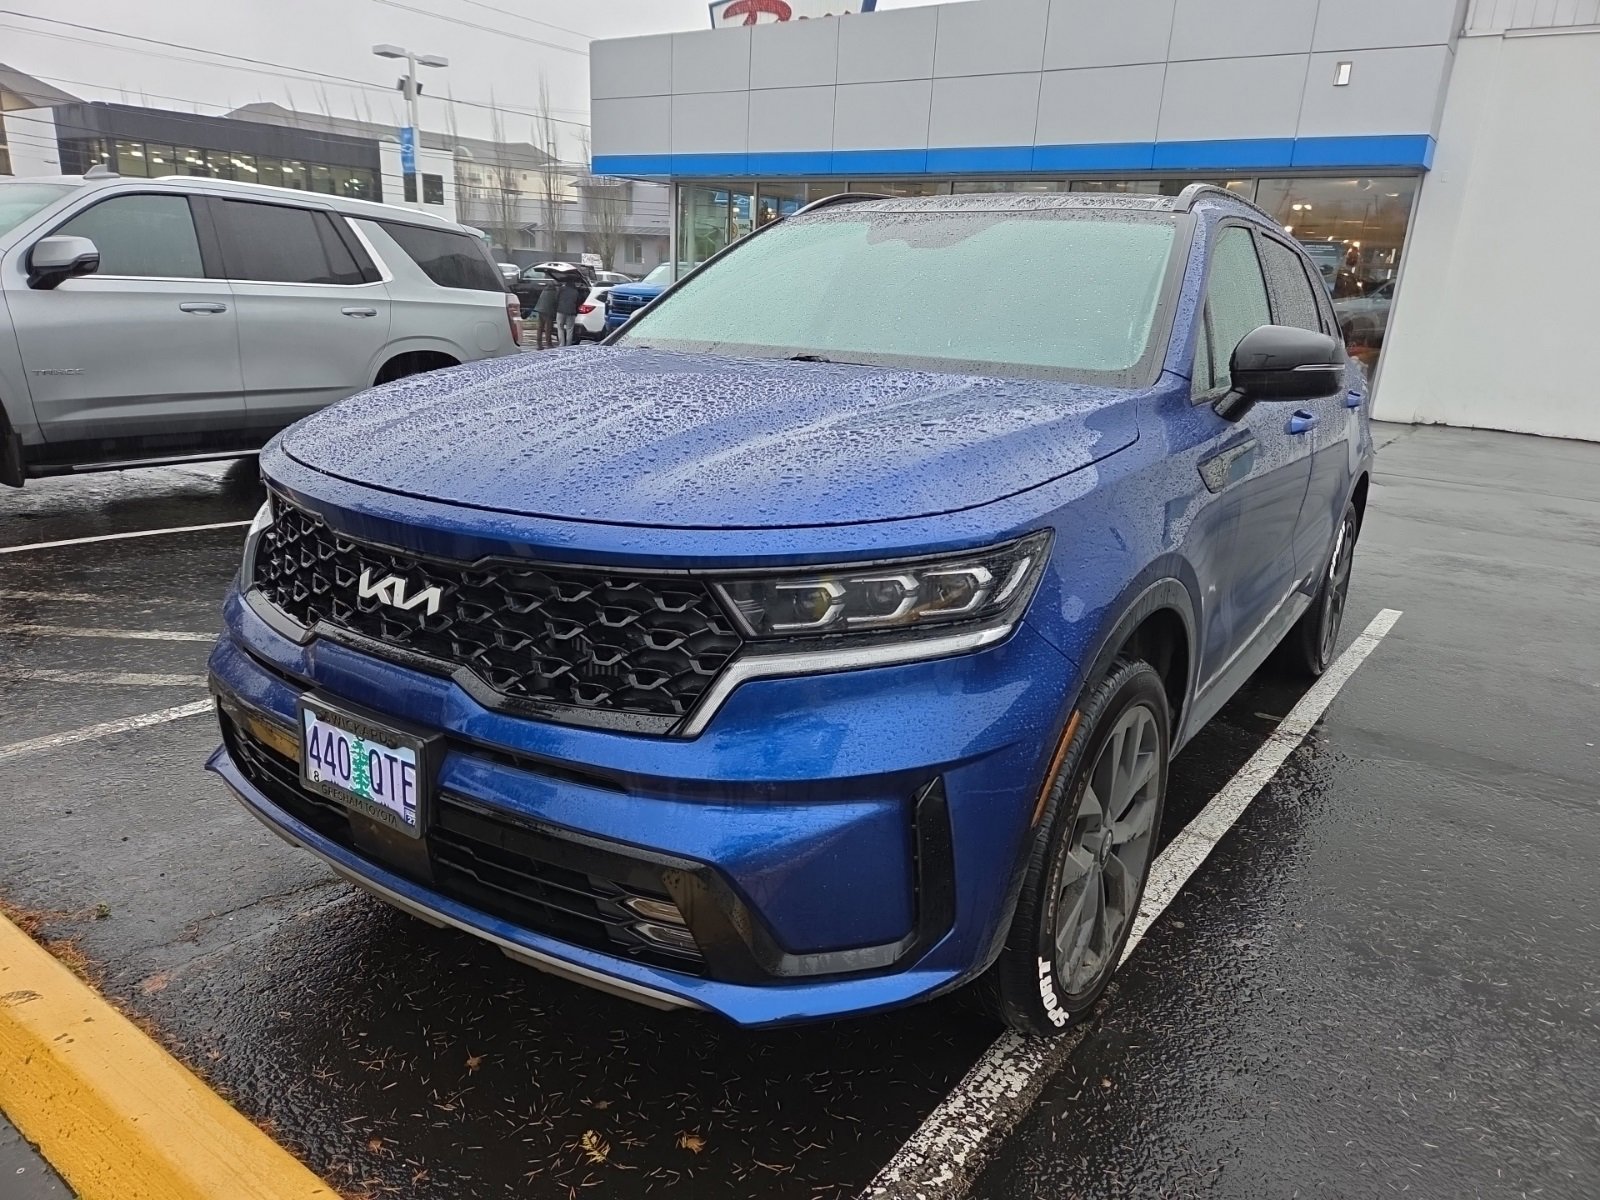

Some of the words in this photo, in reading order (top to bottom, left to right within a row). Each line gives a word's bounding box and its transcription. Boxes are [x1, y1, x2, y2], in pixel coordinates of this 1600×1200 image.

[359, 568, 441, 617] KIA
[309, 725, 351, 781] 440
[368, 748, 416, 809] QTE
[313, 770, 320, 782] 8
[321, 783, 363, 811] GRESHAM
[364, 803, 398, 828] TOYOTA
[1037, 956, 1070, 1028] SPORT
